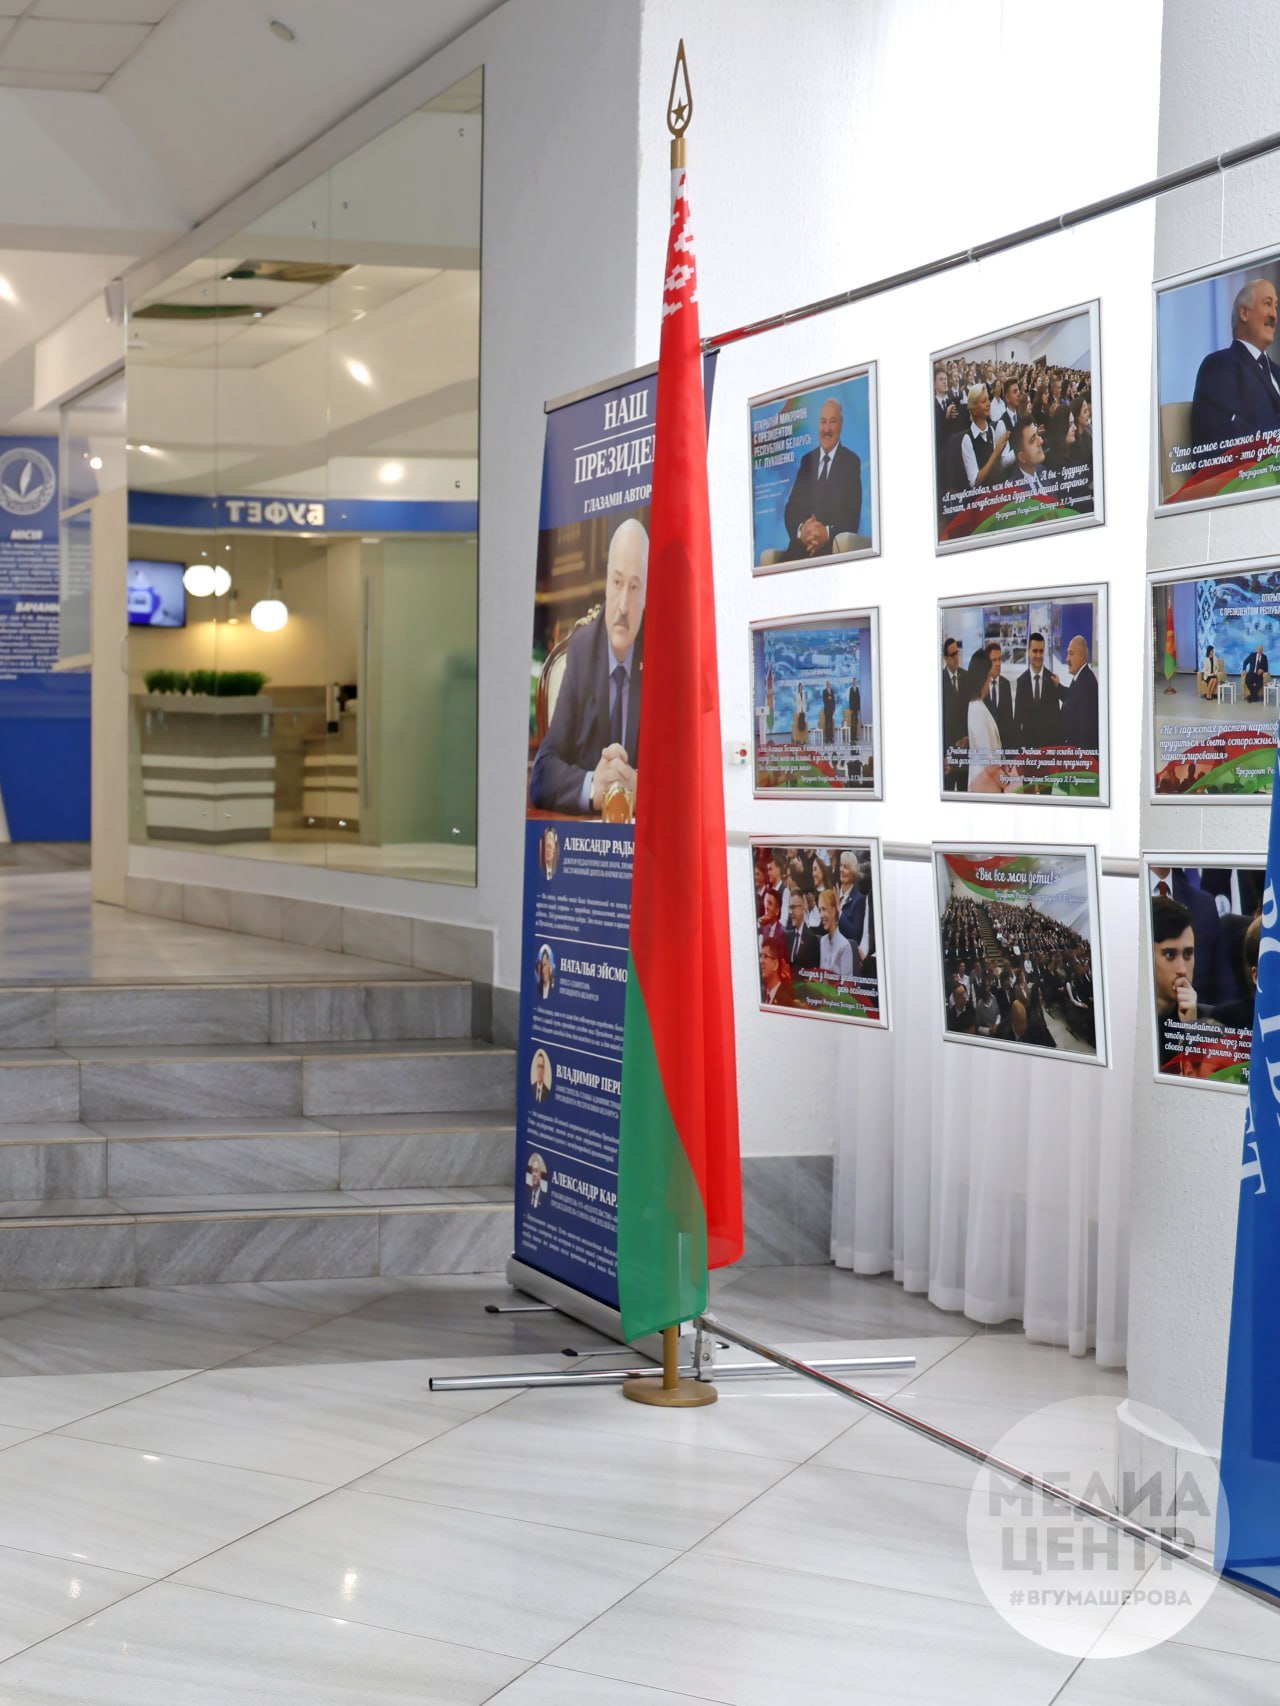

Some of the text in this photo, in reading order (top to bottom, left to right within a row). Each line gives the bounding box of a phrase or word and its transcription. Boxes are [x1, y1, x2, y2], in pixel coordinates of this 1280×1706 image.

[603, 389, 648, 430] НАШ
[1192, 442, 1218, 454] самое
[1219, 434, 1254, 449] сложное
[573, 434, 656, 484] ПРЕЗИДЕ
[1170, 461, 1197, 473] Самое
[1198, 454, 1234, 469] сложное
[583, 490, 624, 514] ГЛАЗАМИ
[563, 837, 611, 856] АЛЕКСАНДР
[993, 868, 1006, 882] все
[1006, 872, 1027, 883] мои
[560, 957, 595, 978] НАТАЛЬЯ
[556, 1064, 600, 1089] ВЛАДИМИР
[551, 1170, 599, 1202] АЛЕКСАНДР
